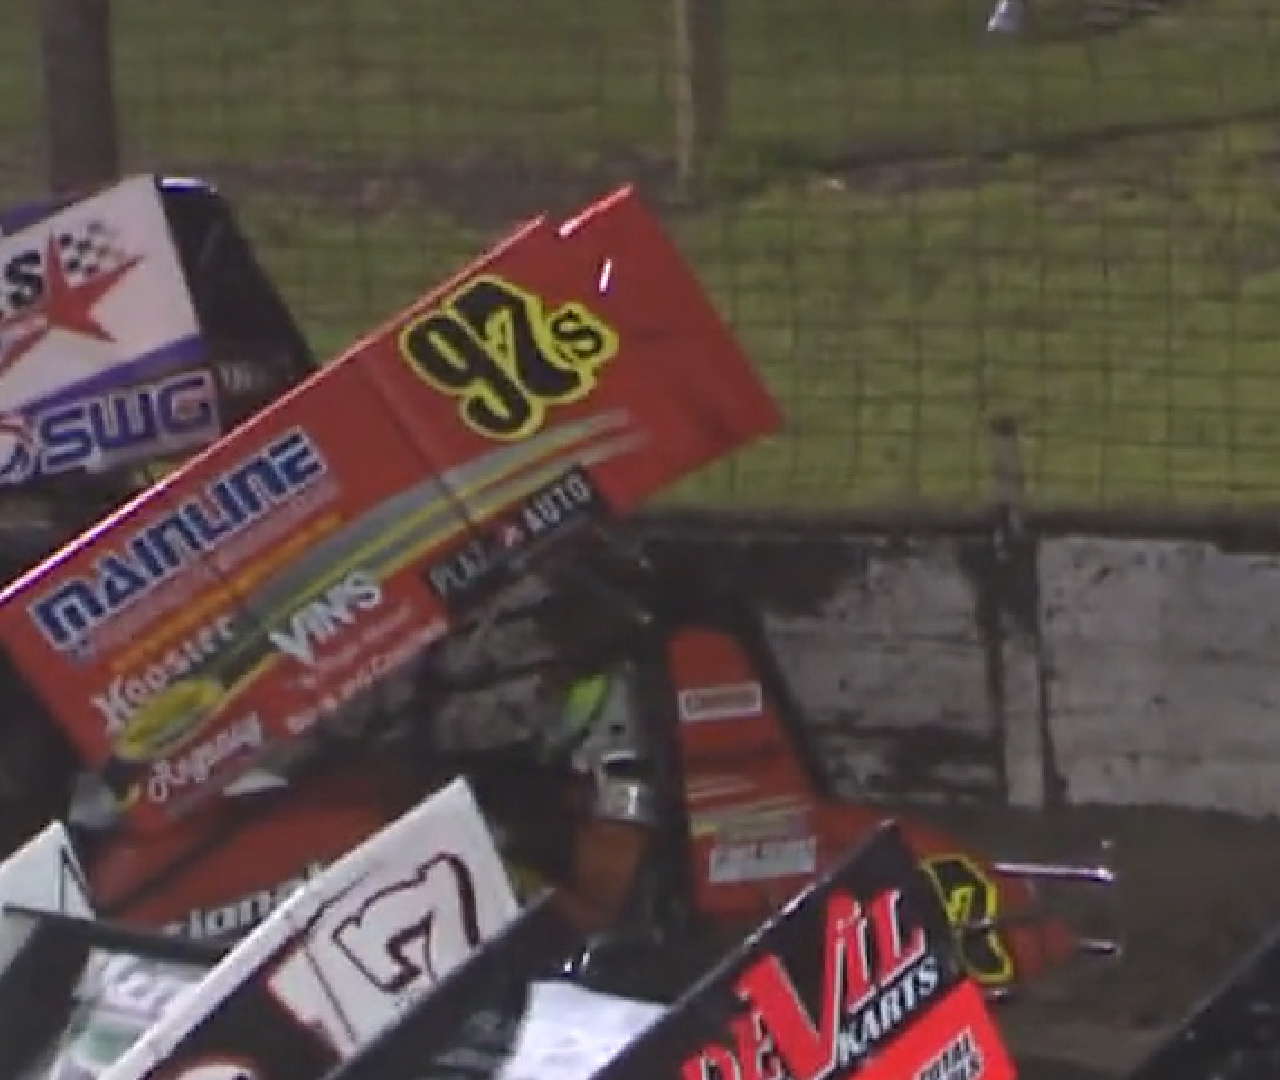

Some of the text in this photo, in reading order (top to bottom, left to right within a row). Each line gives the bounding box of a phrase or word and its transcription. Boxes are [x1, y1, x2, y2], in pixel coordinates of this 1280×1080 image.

[37, 368, 218, 474] SWG
[30, 434, 328, 650] MAINLINE
[834, 955, 942, 1068] KARTS
